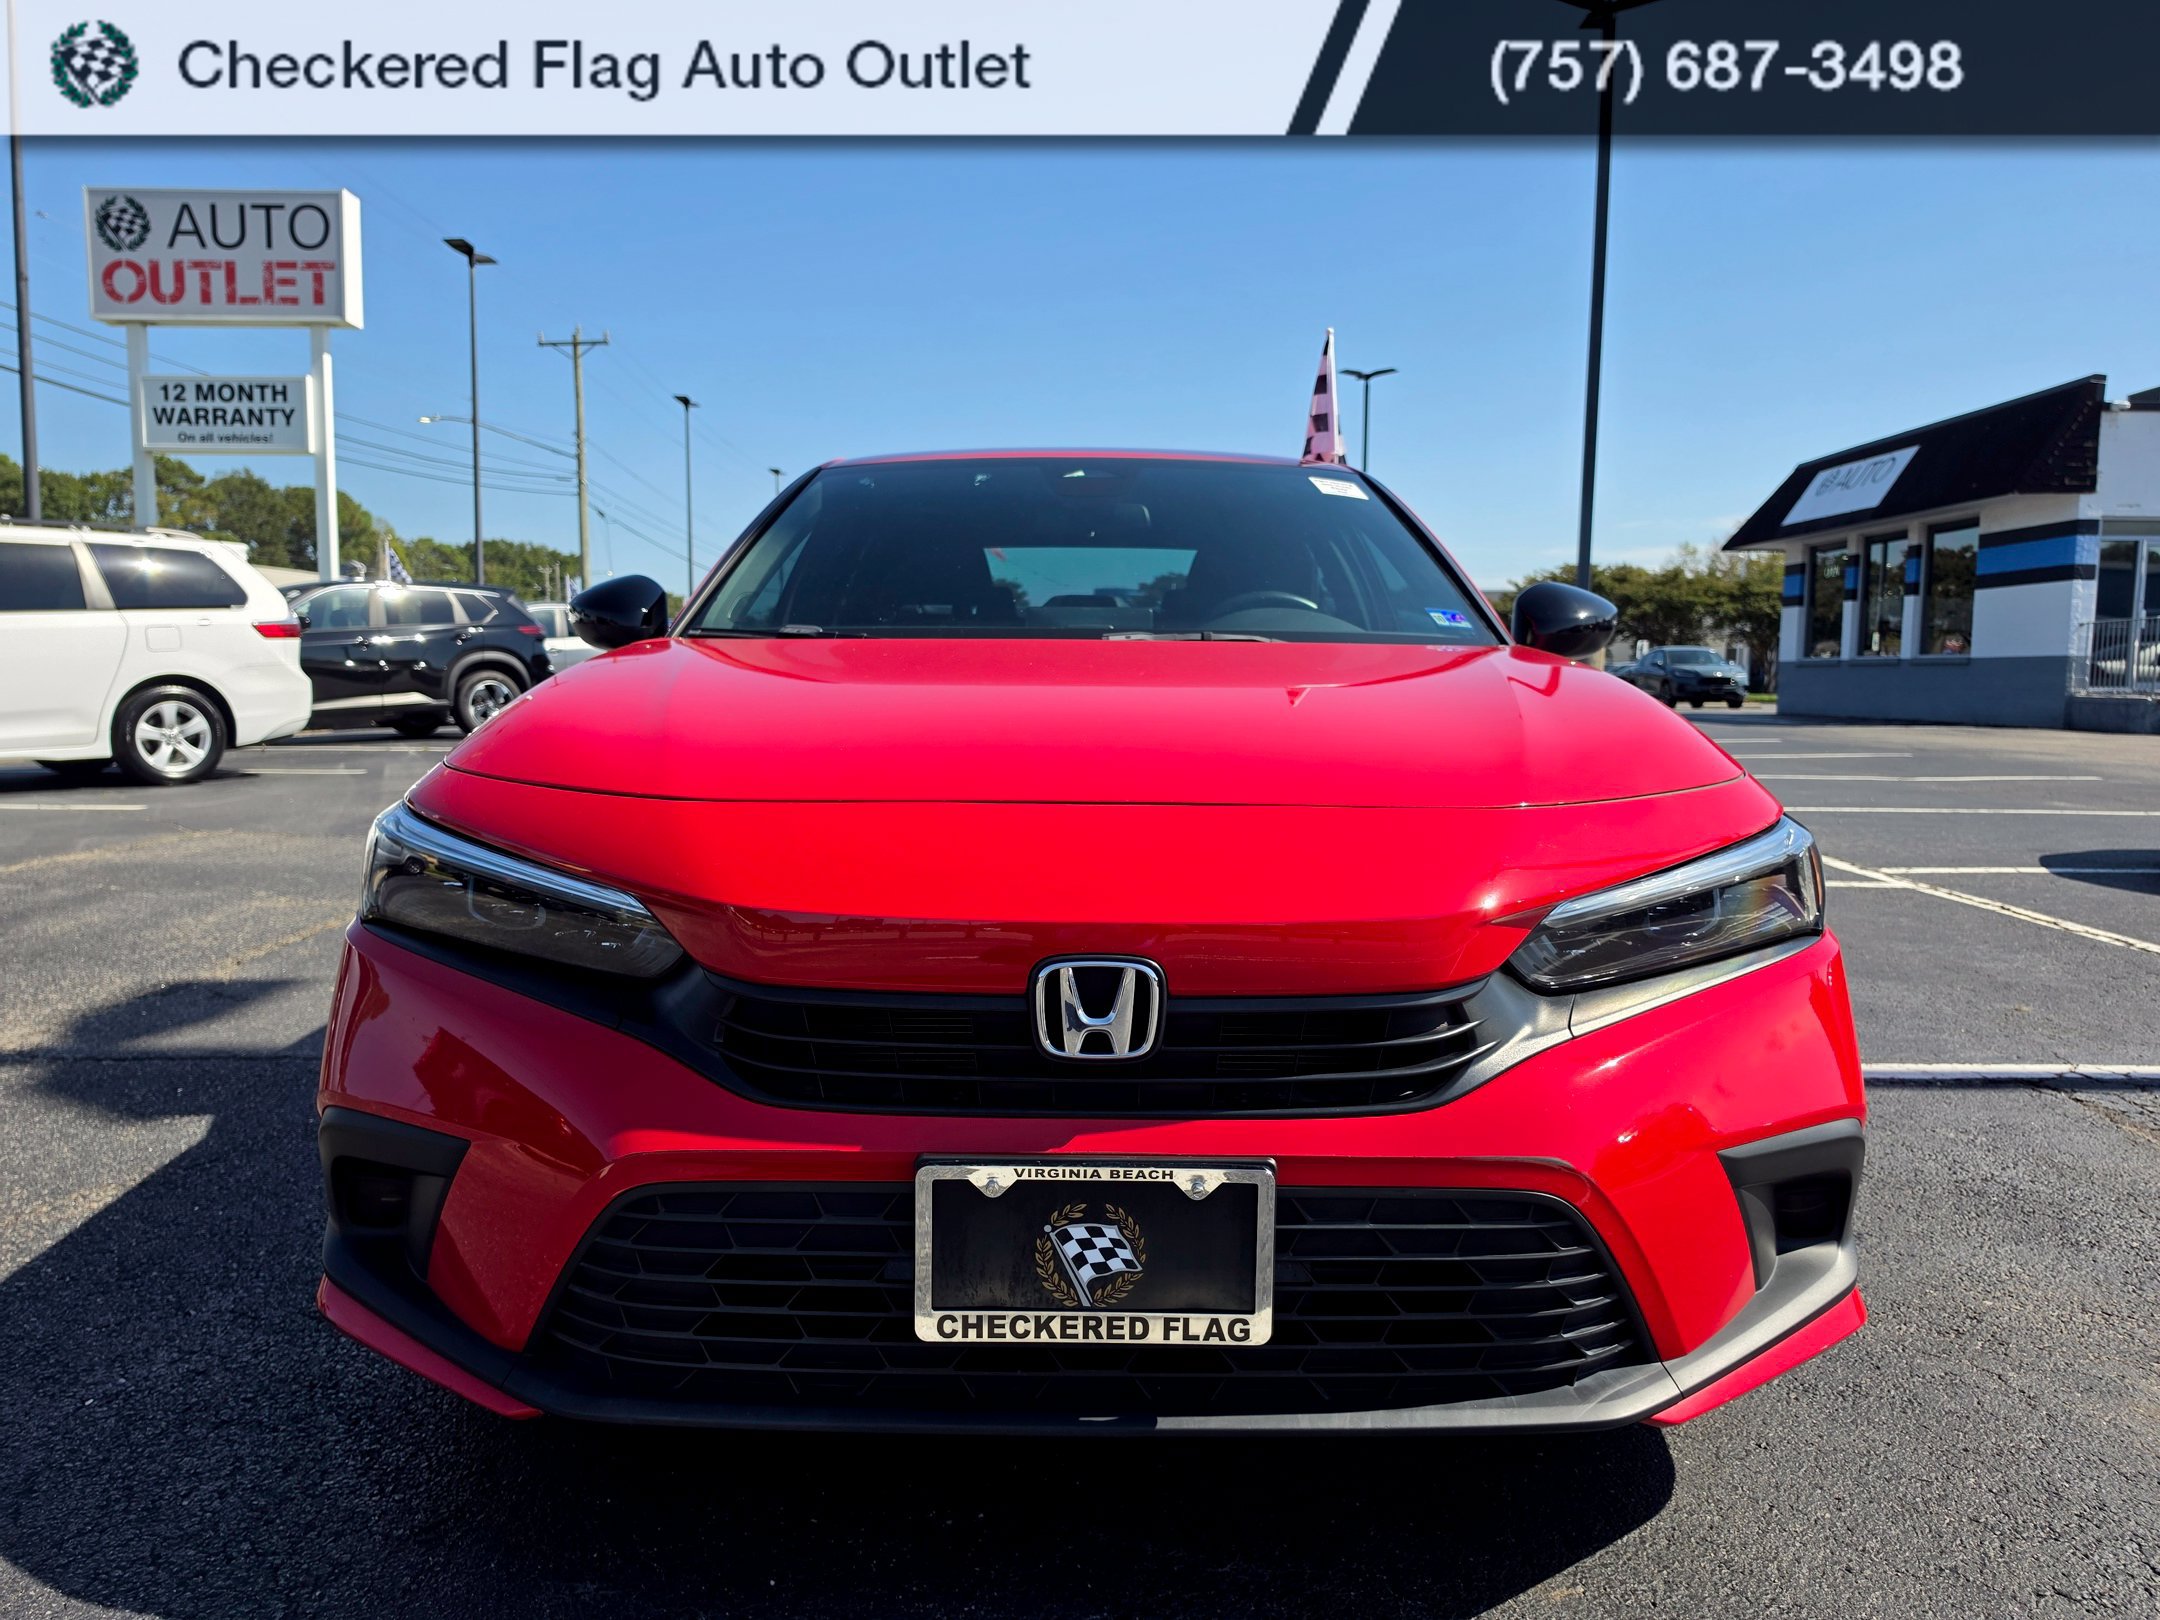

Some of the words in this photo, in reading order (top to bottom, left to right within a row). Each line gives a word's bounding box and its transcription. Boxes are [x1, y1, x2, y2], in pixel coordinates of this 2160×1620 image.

[167, 203, 331, 250] AUTO
[101, 258, 337, 306] OUTLET
[160, 383, 187, 402] 12
[194, 383, 288, 403] MONTH
[152, 407, 296, 427] WARRANTY
[177, 432, 196, 444] On
[199, 432, 214, 444] all
[217, 432, 274, 444] vehicles!
[1013, 1167, 1103, 1180] VIRGINIA
[1109, 1168, 1175, 1181] BEACH
[935, 1314, 1151, 1341] CHECKERED
[1162, 1316, 1252, 1342] FLAG
